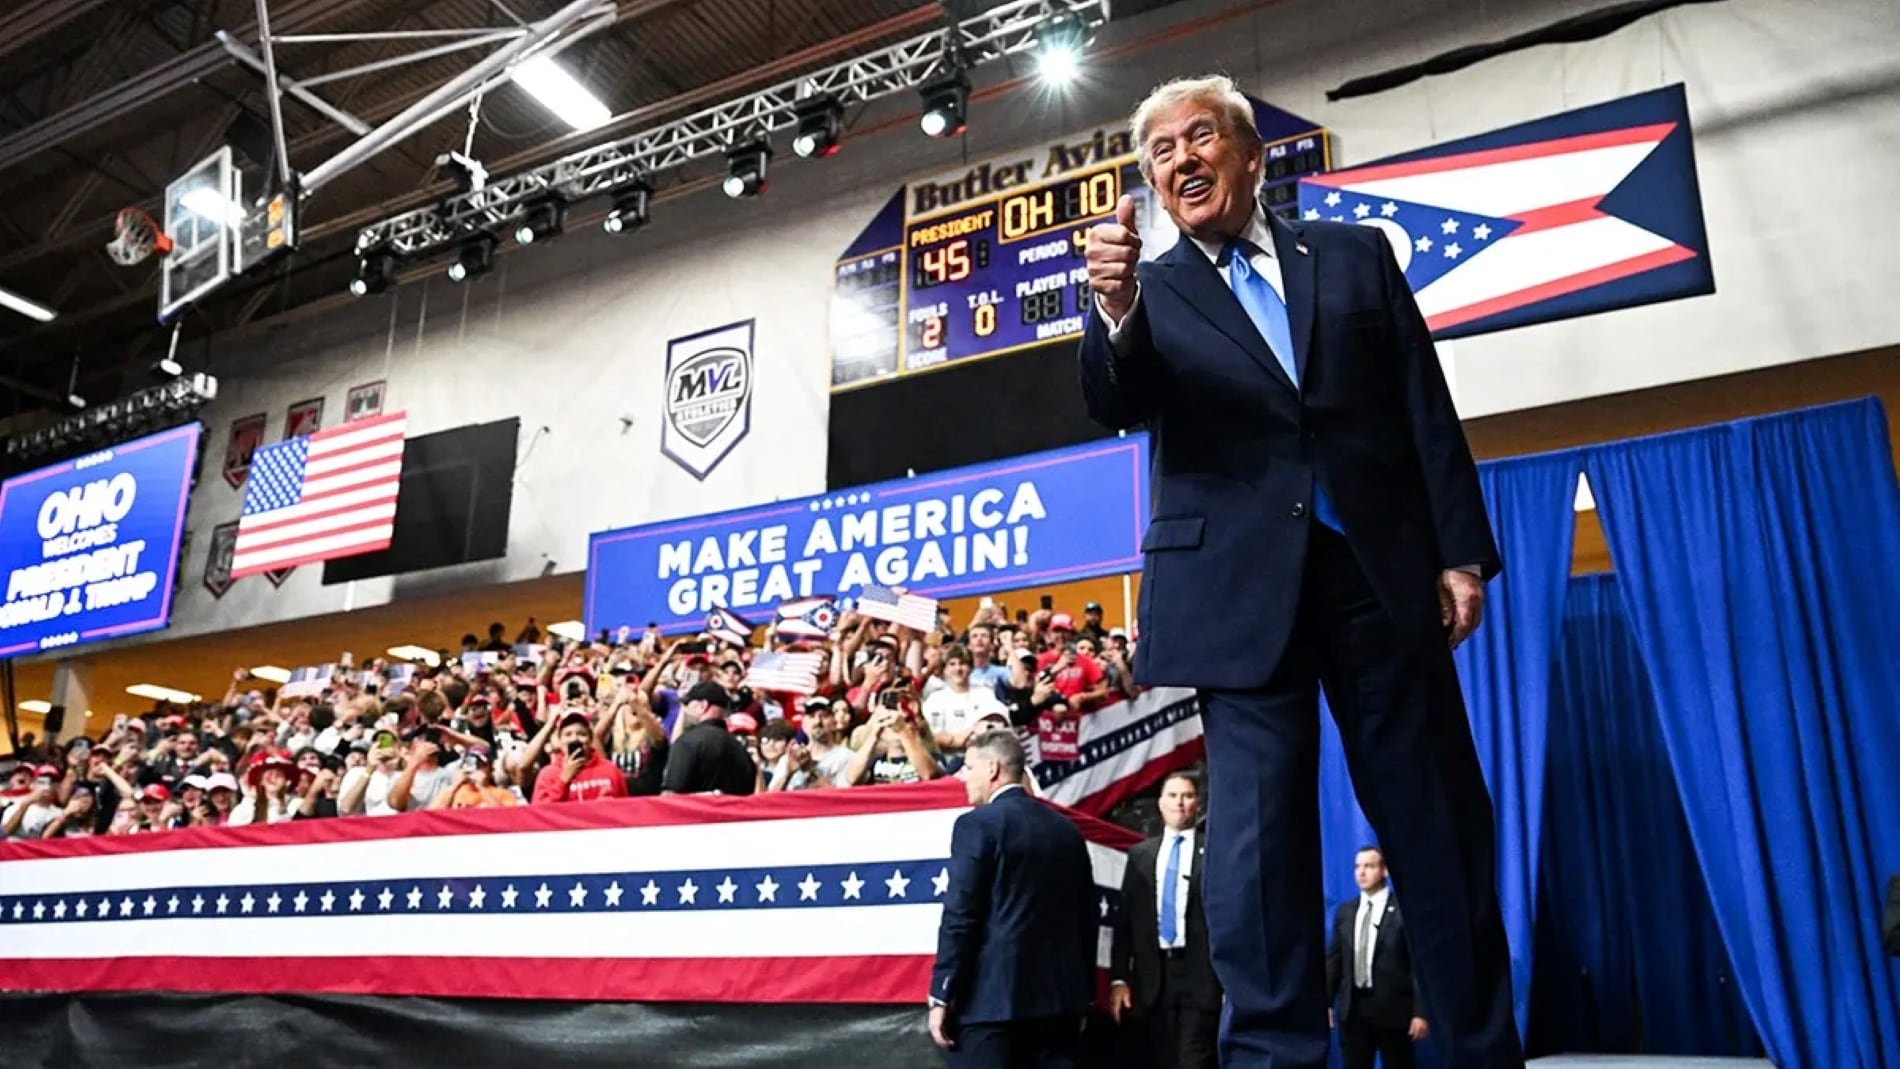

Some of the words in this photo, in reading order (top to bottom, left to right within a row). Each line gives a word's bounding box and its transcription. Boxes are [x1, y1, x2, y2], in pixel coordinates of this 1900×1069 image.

[912, 160, 1034, 215] Butler
[1004, 191, 1054, 238] OH
[1078, 172, 1115, 216] 10
[911, 210, 994, 247] PRESIDENT
[923, 240, 970, 282] 45
[1018, 239, 1068, 265] PERIOD
[1016, 272, 1067, 298] PLAYER
[908, 301, 949, 324] FOULS
[922, 317, 942, 348] 2
[1036, 316, 1083, 340] MATCH
[674, 362, 742, 403] MVL
[37, 472, 137, 539] OHIO
[42, 523, 118, 558] WELCOMES
[658, 525, 788, 579] MAKE
[803, 481, 1047, 557] AMERICA
[6, 539, 146, 602] PRESIDENT
[85, 570, 158, 611] TRUMP
[667, 560, 822, 616] GREAT
[838, 525, 1029, 592] AGAIN!
